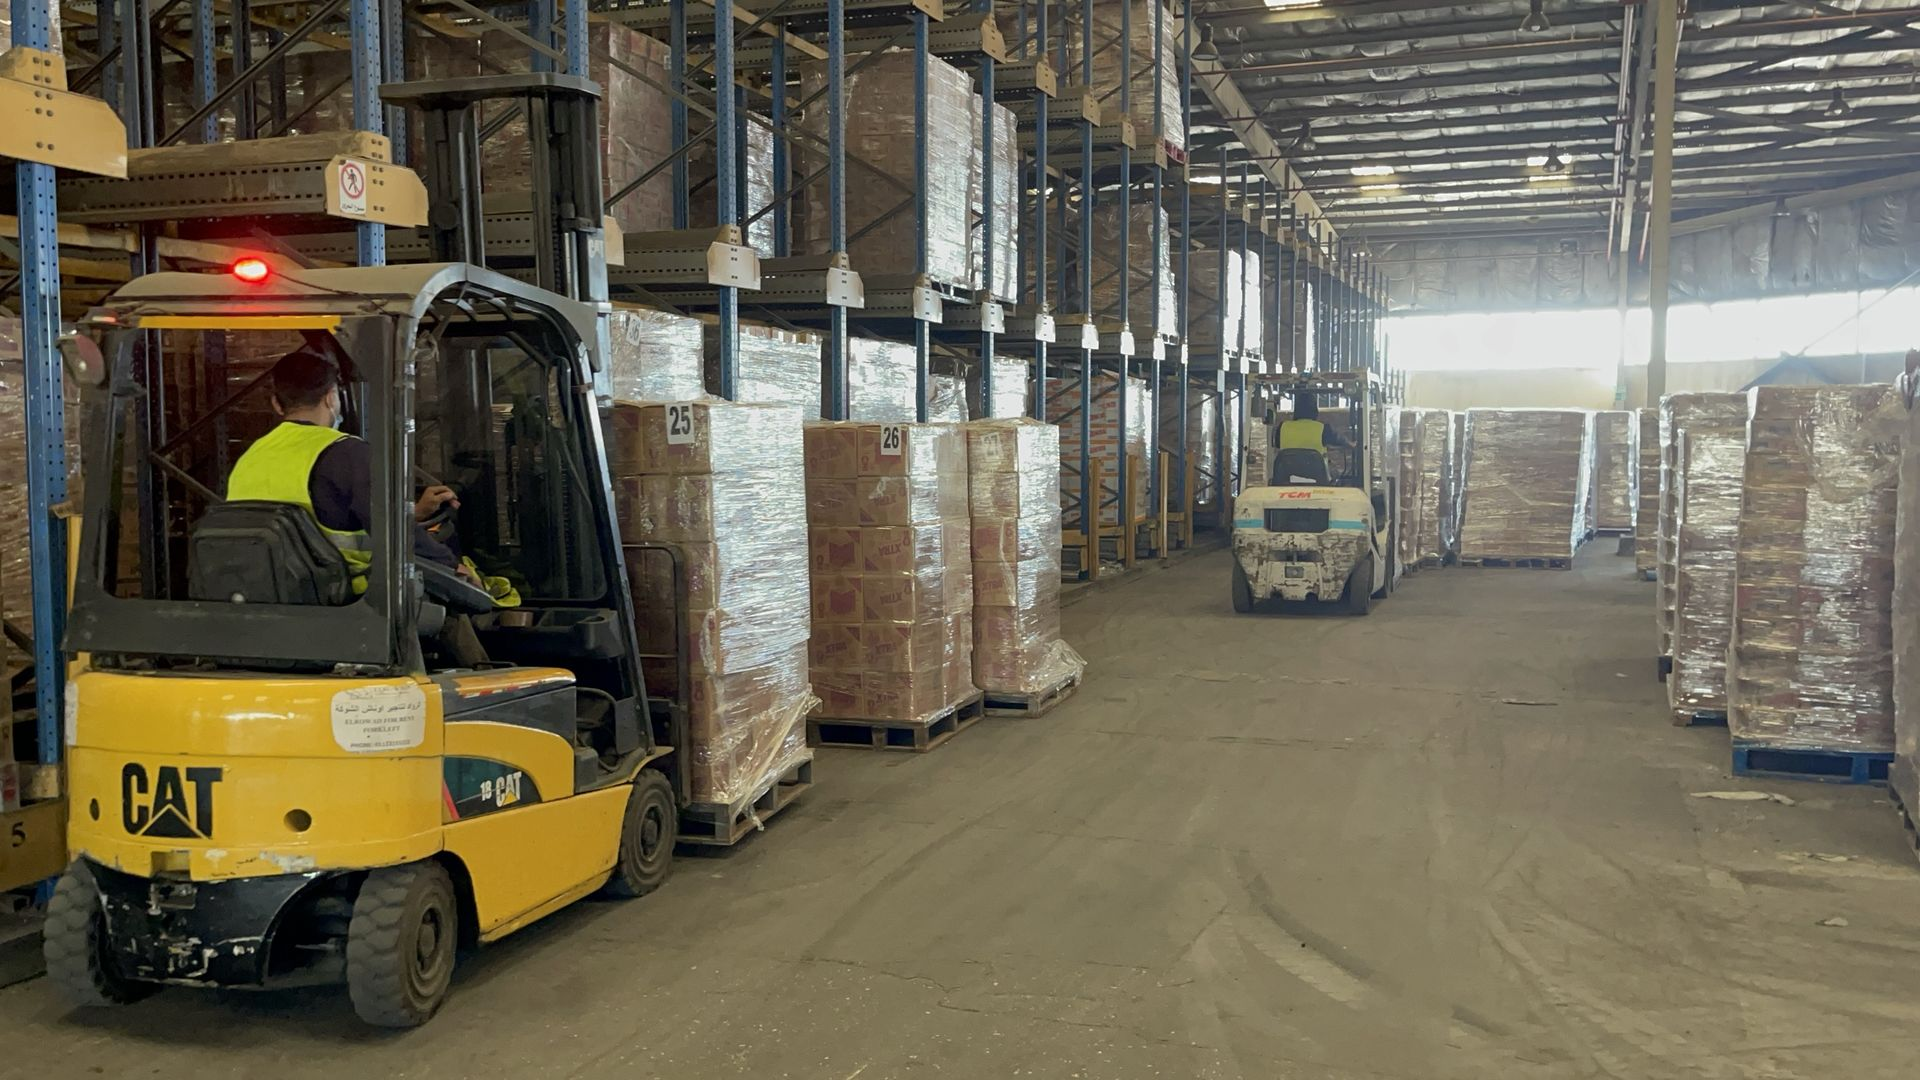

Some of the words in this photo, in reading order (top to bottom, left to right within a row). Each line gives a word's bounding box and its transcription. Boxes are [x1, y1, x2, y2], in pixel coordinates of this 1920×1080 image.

[669, 405, 691, 435] 25
[883, 427, 899, 449] 26
[1279, 491, 1311, 499] TCM
[878, 543, 901, 557] XTRA
[880, 592, 902, 605] XTRA
[122, 762, 223, 839] CAT
[480, 780, 492, 801] 18
[496, 771, 522, 807] CAT
[12, 822, 26, 847] 5
